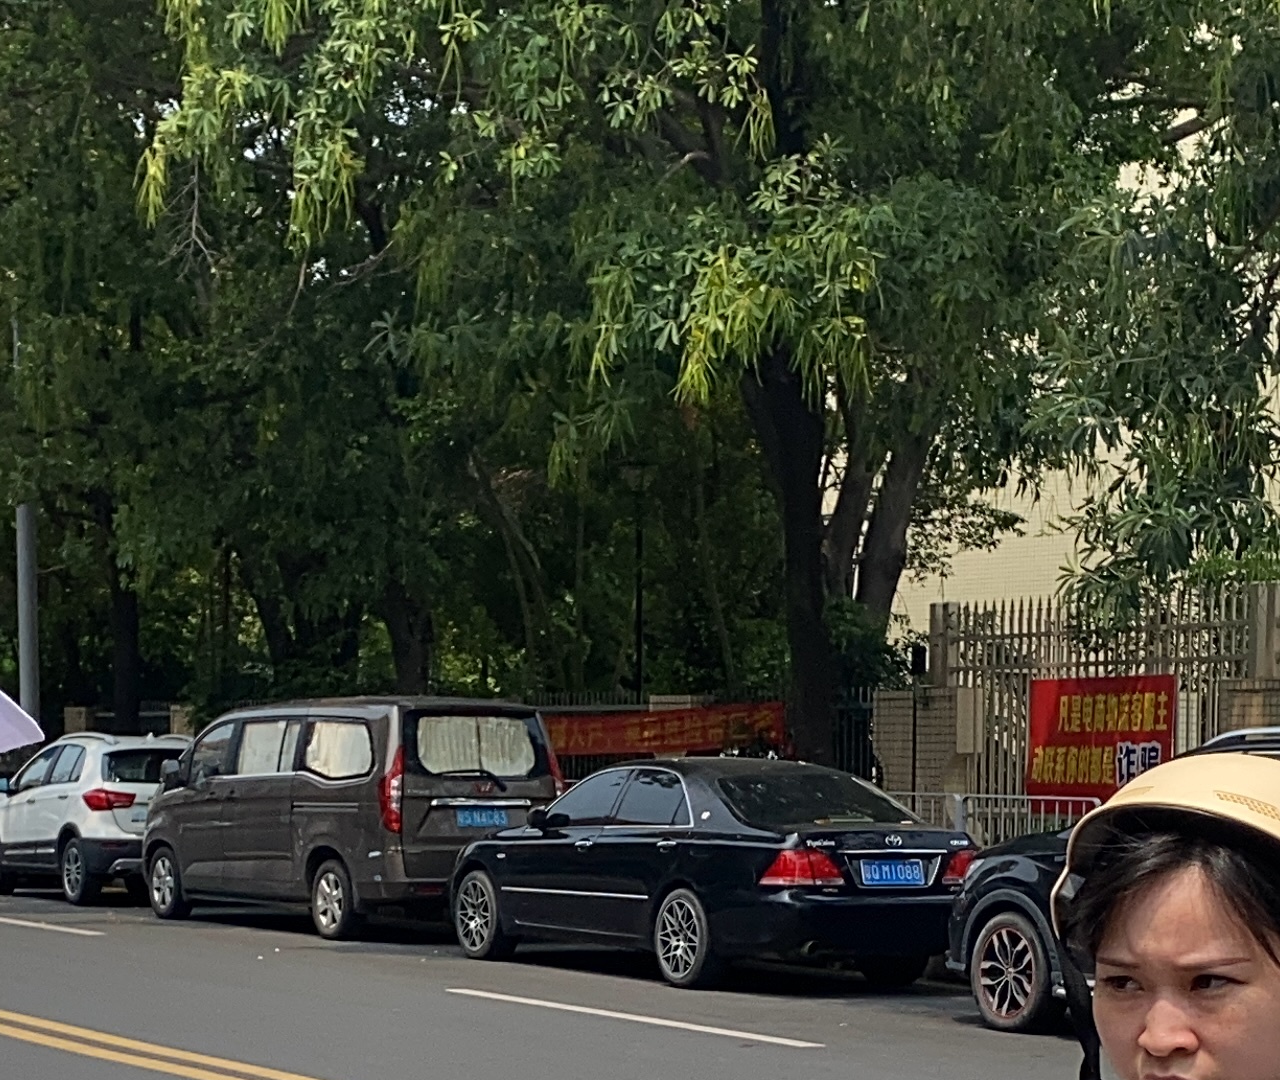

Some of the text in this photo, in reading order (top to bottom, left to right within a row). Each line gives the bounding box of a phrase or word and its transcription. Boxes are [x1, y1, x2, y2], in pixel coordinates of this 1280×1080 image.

[1058, 691, 1168, 732] 凡是电商物流客服主
